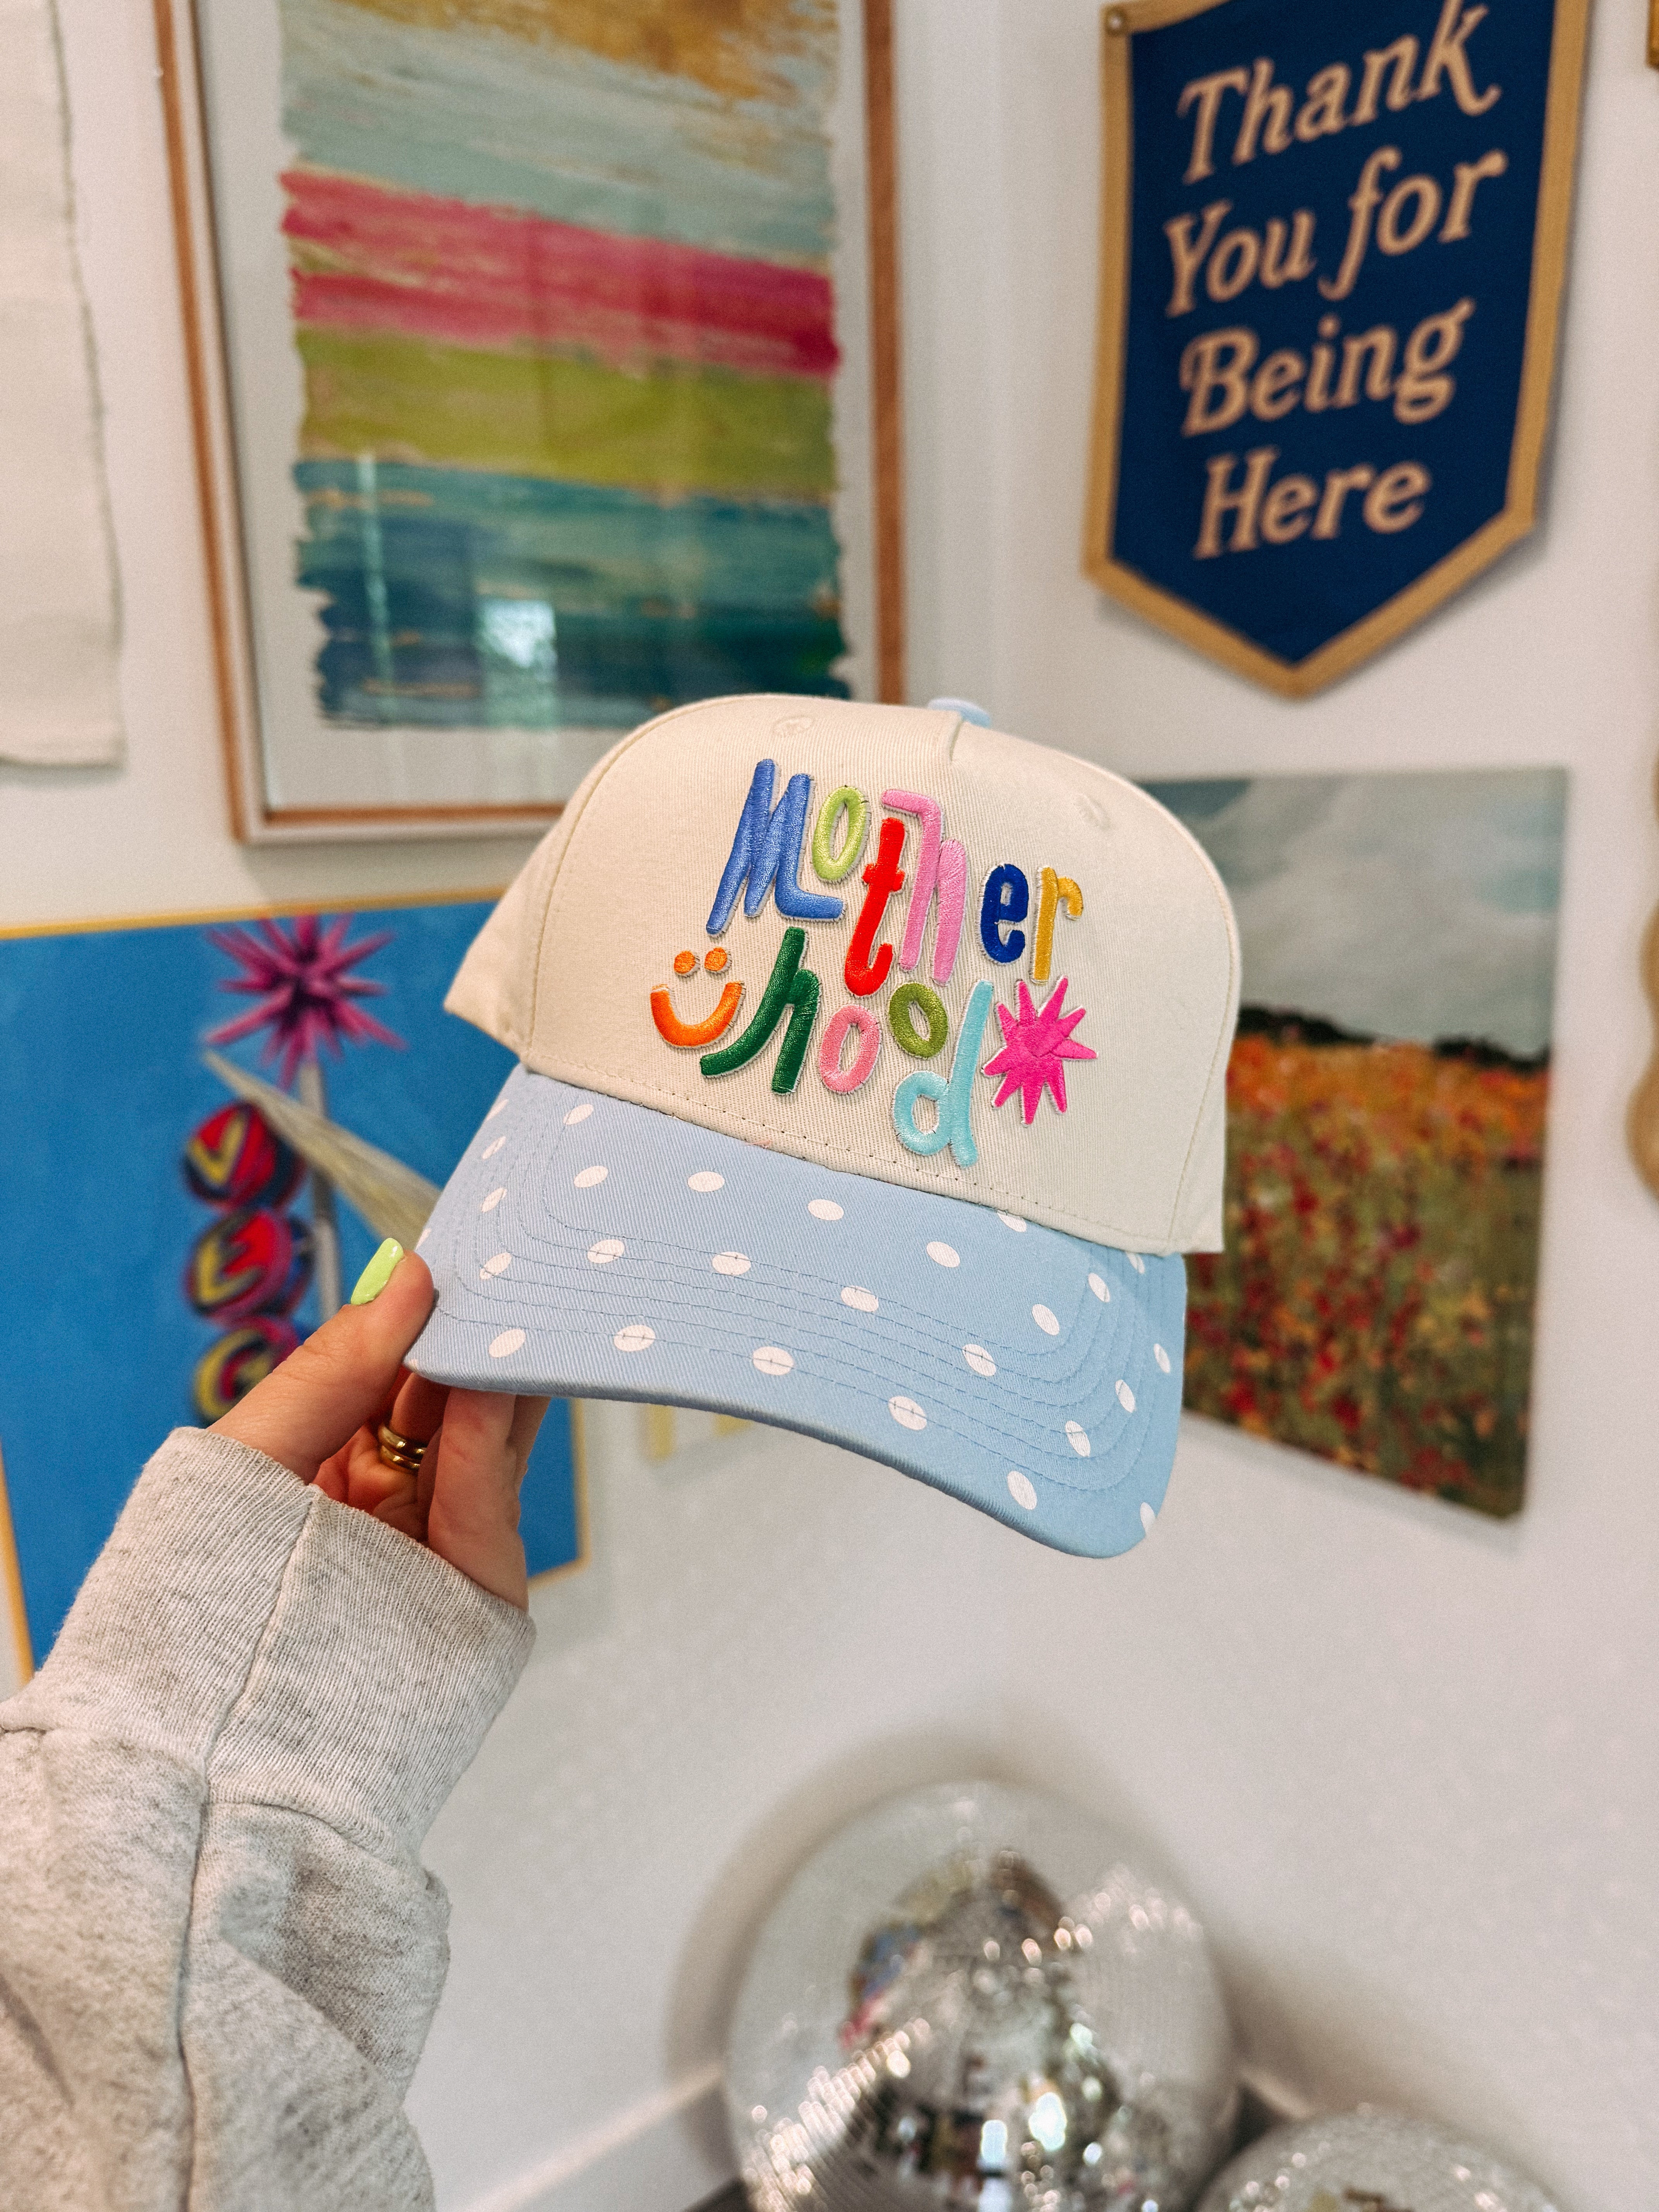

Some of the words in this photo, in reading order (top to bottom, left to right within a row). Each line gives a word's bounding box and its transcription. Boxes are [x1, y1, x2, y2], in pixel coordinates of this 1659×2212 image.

[1177, 0, 1501, 184] Thank
[1165, 200, 1317, 318] You
[1319, 146, 1508, 300] for
[1178, 298, 1475, 437] Being
[1194, 446, 1432, 560] Here
[706, 759, 1083, 996] Mother
[700, 927, 994, 1167] hood
